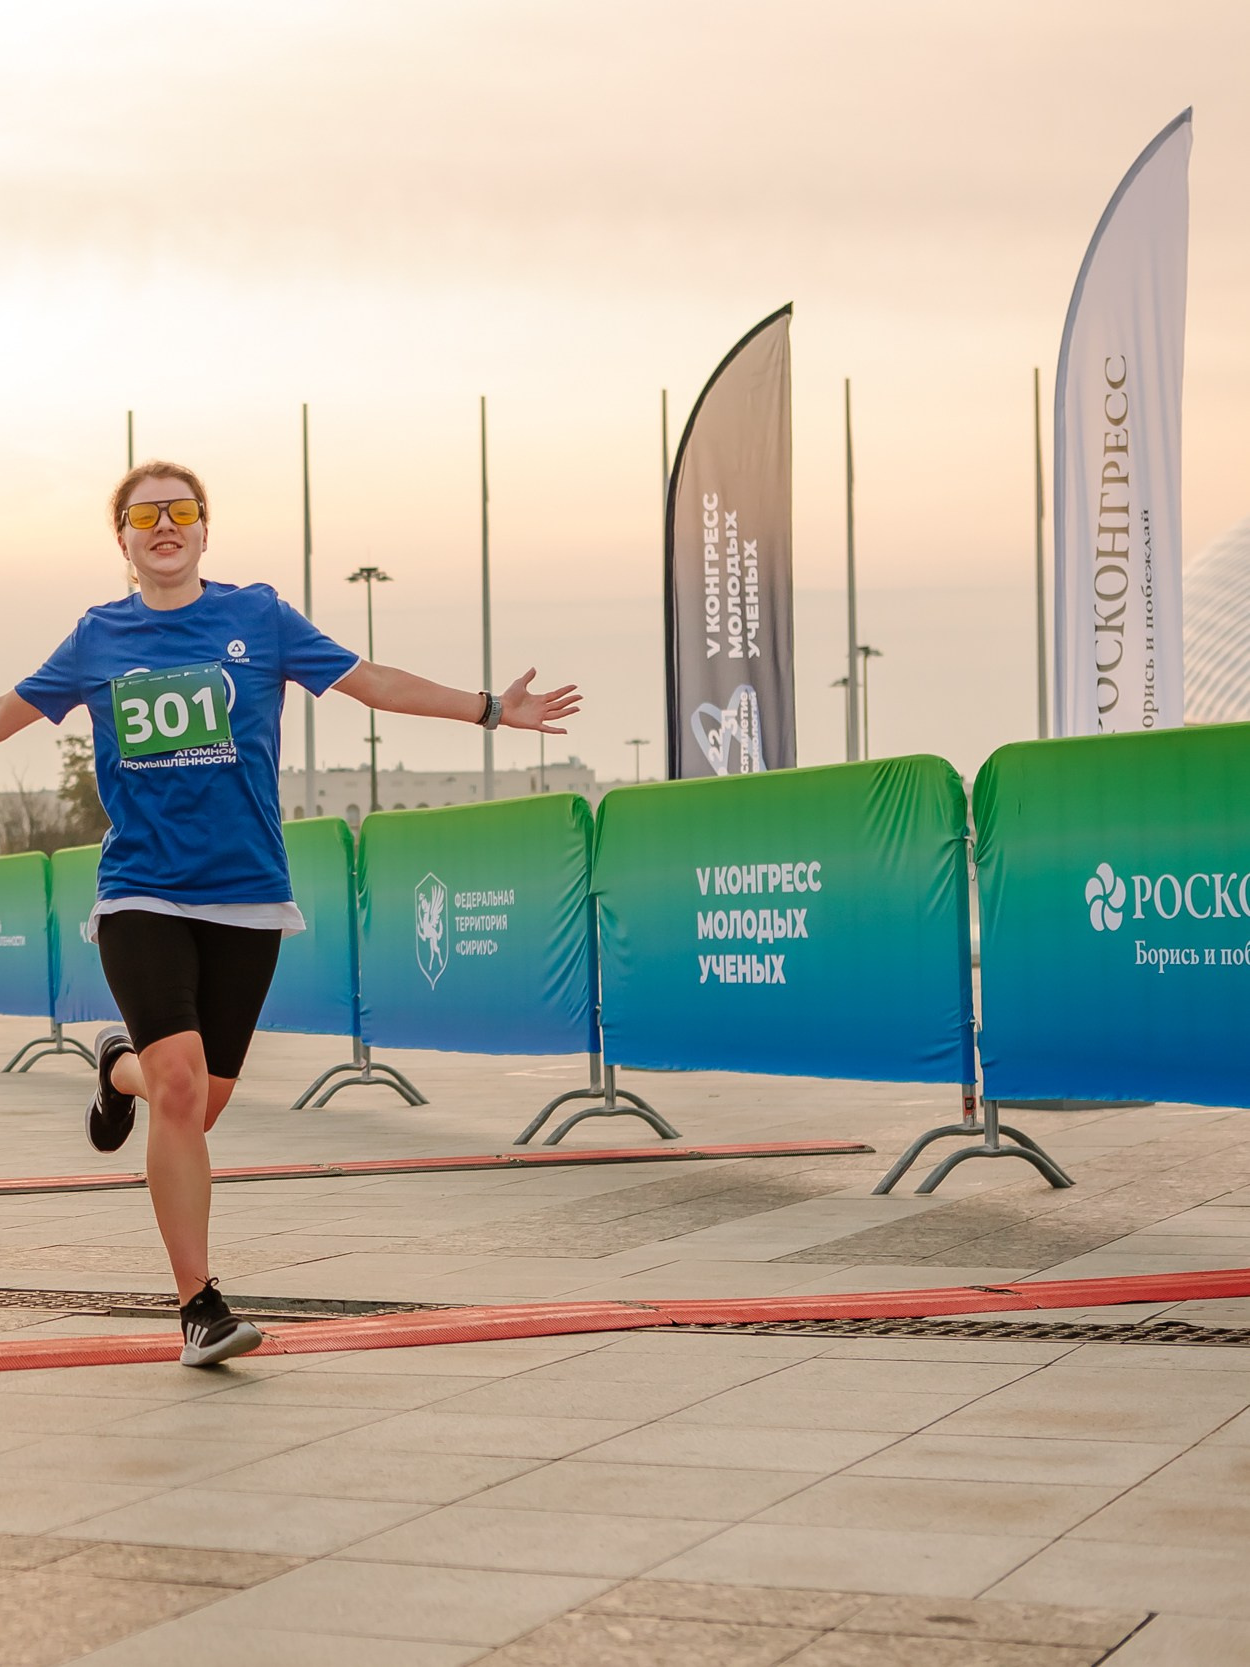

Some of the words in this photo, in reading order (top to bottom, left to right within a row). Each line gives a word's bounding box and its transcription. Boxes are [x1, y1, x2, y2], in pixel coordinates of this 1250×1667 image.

[1094, 355, 1130, 733] ОСКОНГРЕСС
[703, 492, 720, 633] КОНГРЕСС
[724, 510, 744, 659] МОЛОДЫХ
[743, 539, 760, 659] УЧЕНЫХ
[706, 637, 721, 659] V
[1146, 637, 1154, 650] и
[1142, 658, 1159, 729] орись
[121, 687, 217, 744] 301
[119, 755, 237, 770] ПРОМЫШЛЕННОСТИ
[174, 746, 237, 758] АТОМНОЙ
[696, 867, 711, 896] V
[714, 861, 823, 895] КОНГРЕСС
[454, 889, 515, 910] ФЕДЕРАЛЬНАЯ
[455, 914, 508, 932] ТЕРРИТОРИЯ
[697, 908, 809, 944] МОЛОДЫХ
[455, 939, 498, 956] «СИРИУС»
[1135, 940, 1200, 974] Борись
[1204, 948, 1216, 965] и
[698, 954, 787, 984] УЧЕНЫХ
